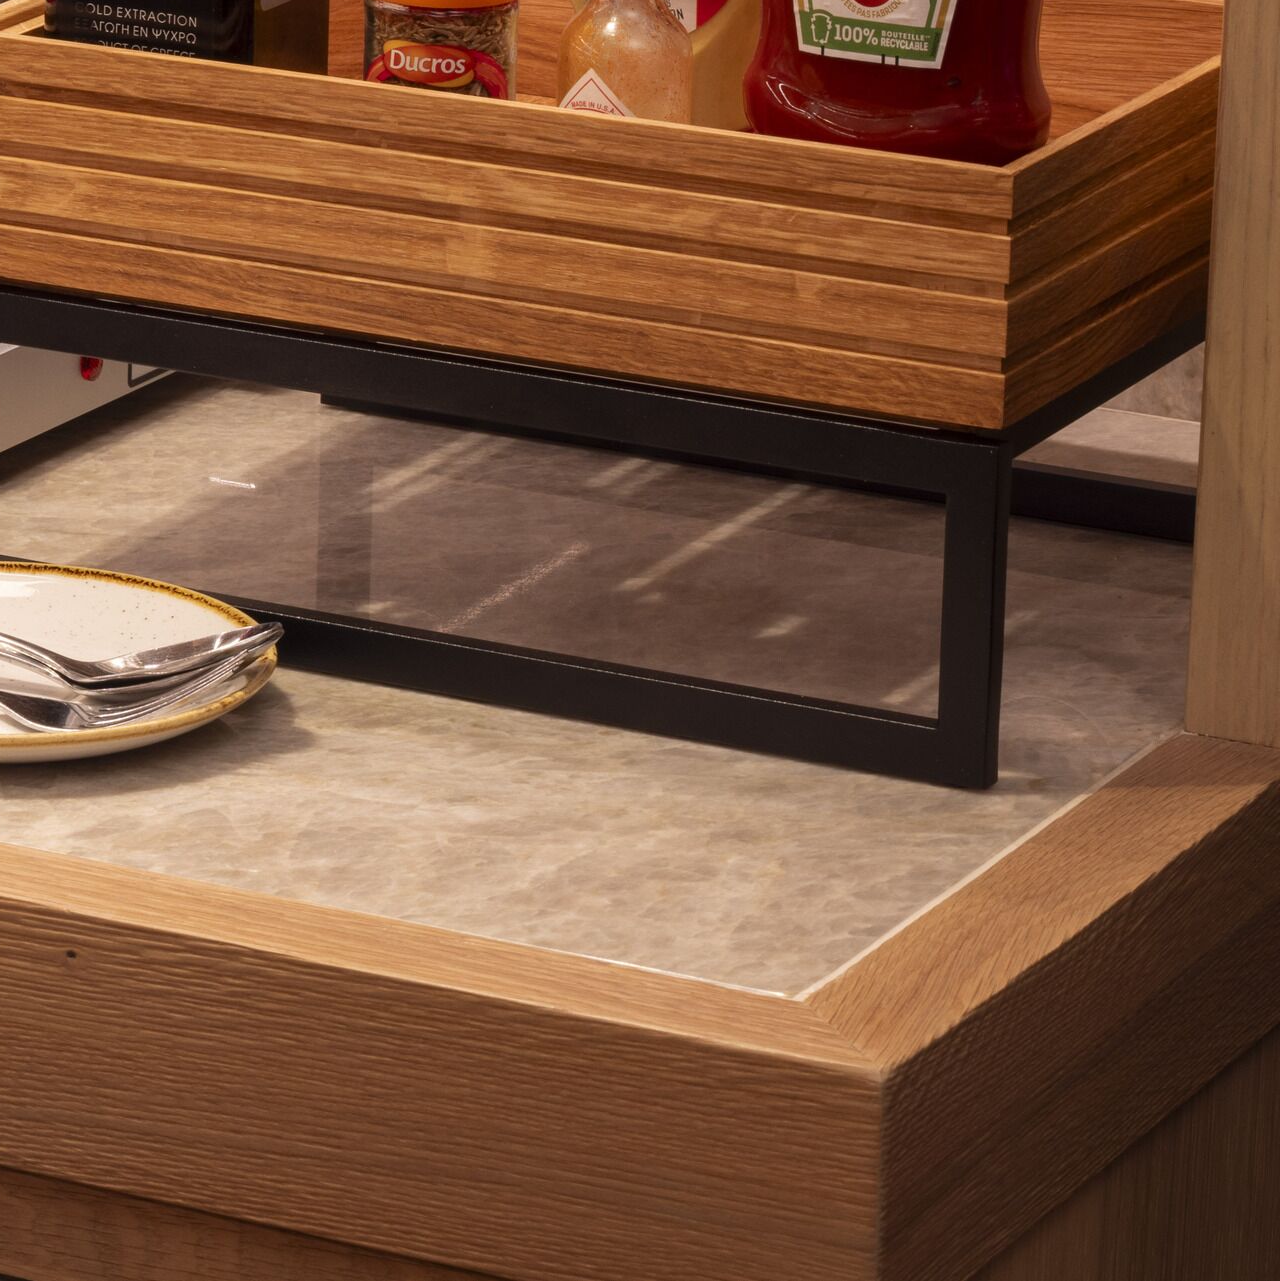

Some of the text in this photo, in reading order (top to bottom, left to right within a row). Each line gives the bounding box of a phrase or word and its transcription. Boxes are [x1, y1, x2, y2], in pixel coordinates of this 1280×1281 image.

[75, 1, 197, 28] COLD EXTRACTION
[856, 7, 871, 18] PAS
[834, 24, 878, 46] 100%
[880, 37, 928, 51] RECYCLABLE
[390, 49, 466, 74] Ducros
[571, 100, 587, 108] MADE
